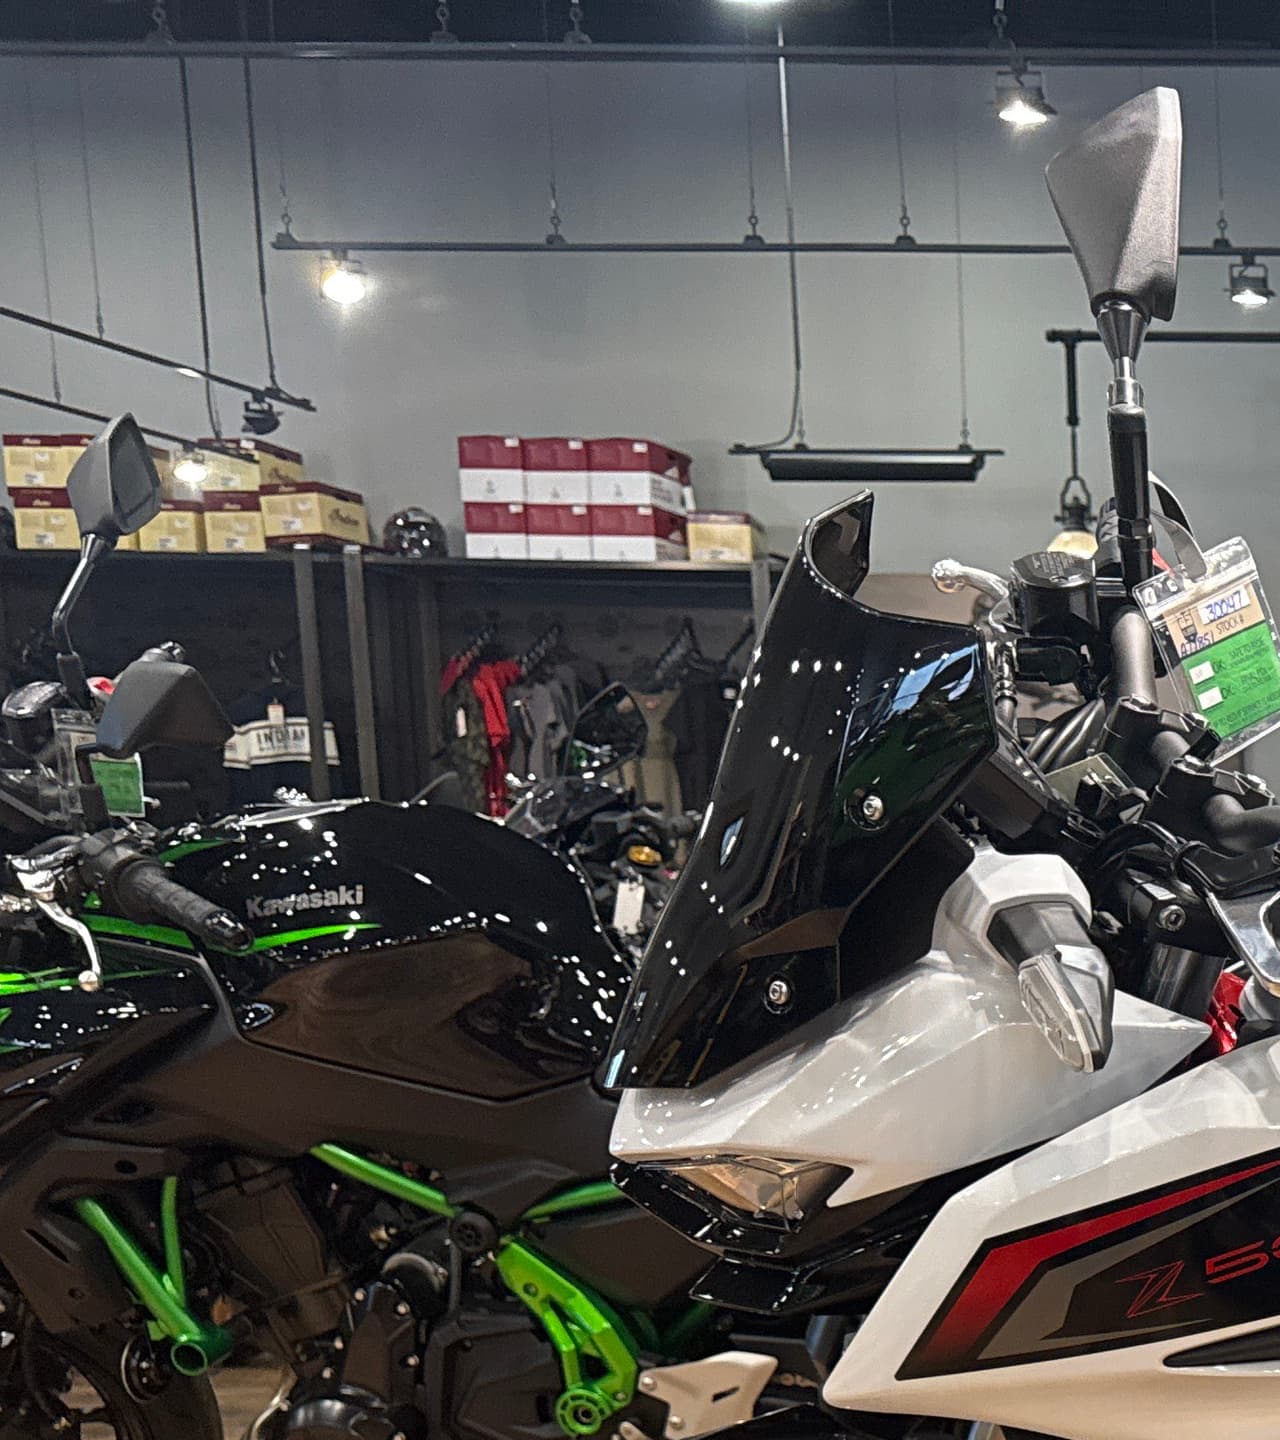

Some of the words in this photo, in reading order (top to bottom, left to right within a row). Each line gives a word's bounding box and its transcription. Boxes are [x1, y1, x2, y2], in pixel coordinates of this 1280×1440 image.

[1206, 590, 1243, 619] 30047
[1215, 615, 1240, 635] STOCK
[246, 884, 364, 919] Kawasaki
